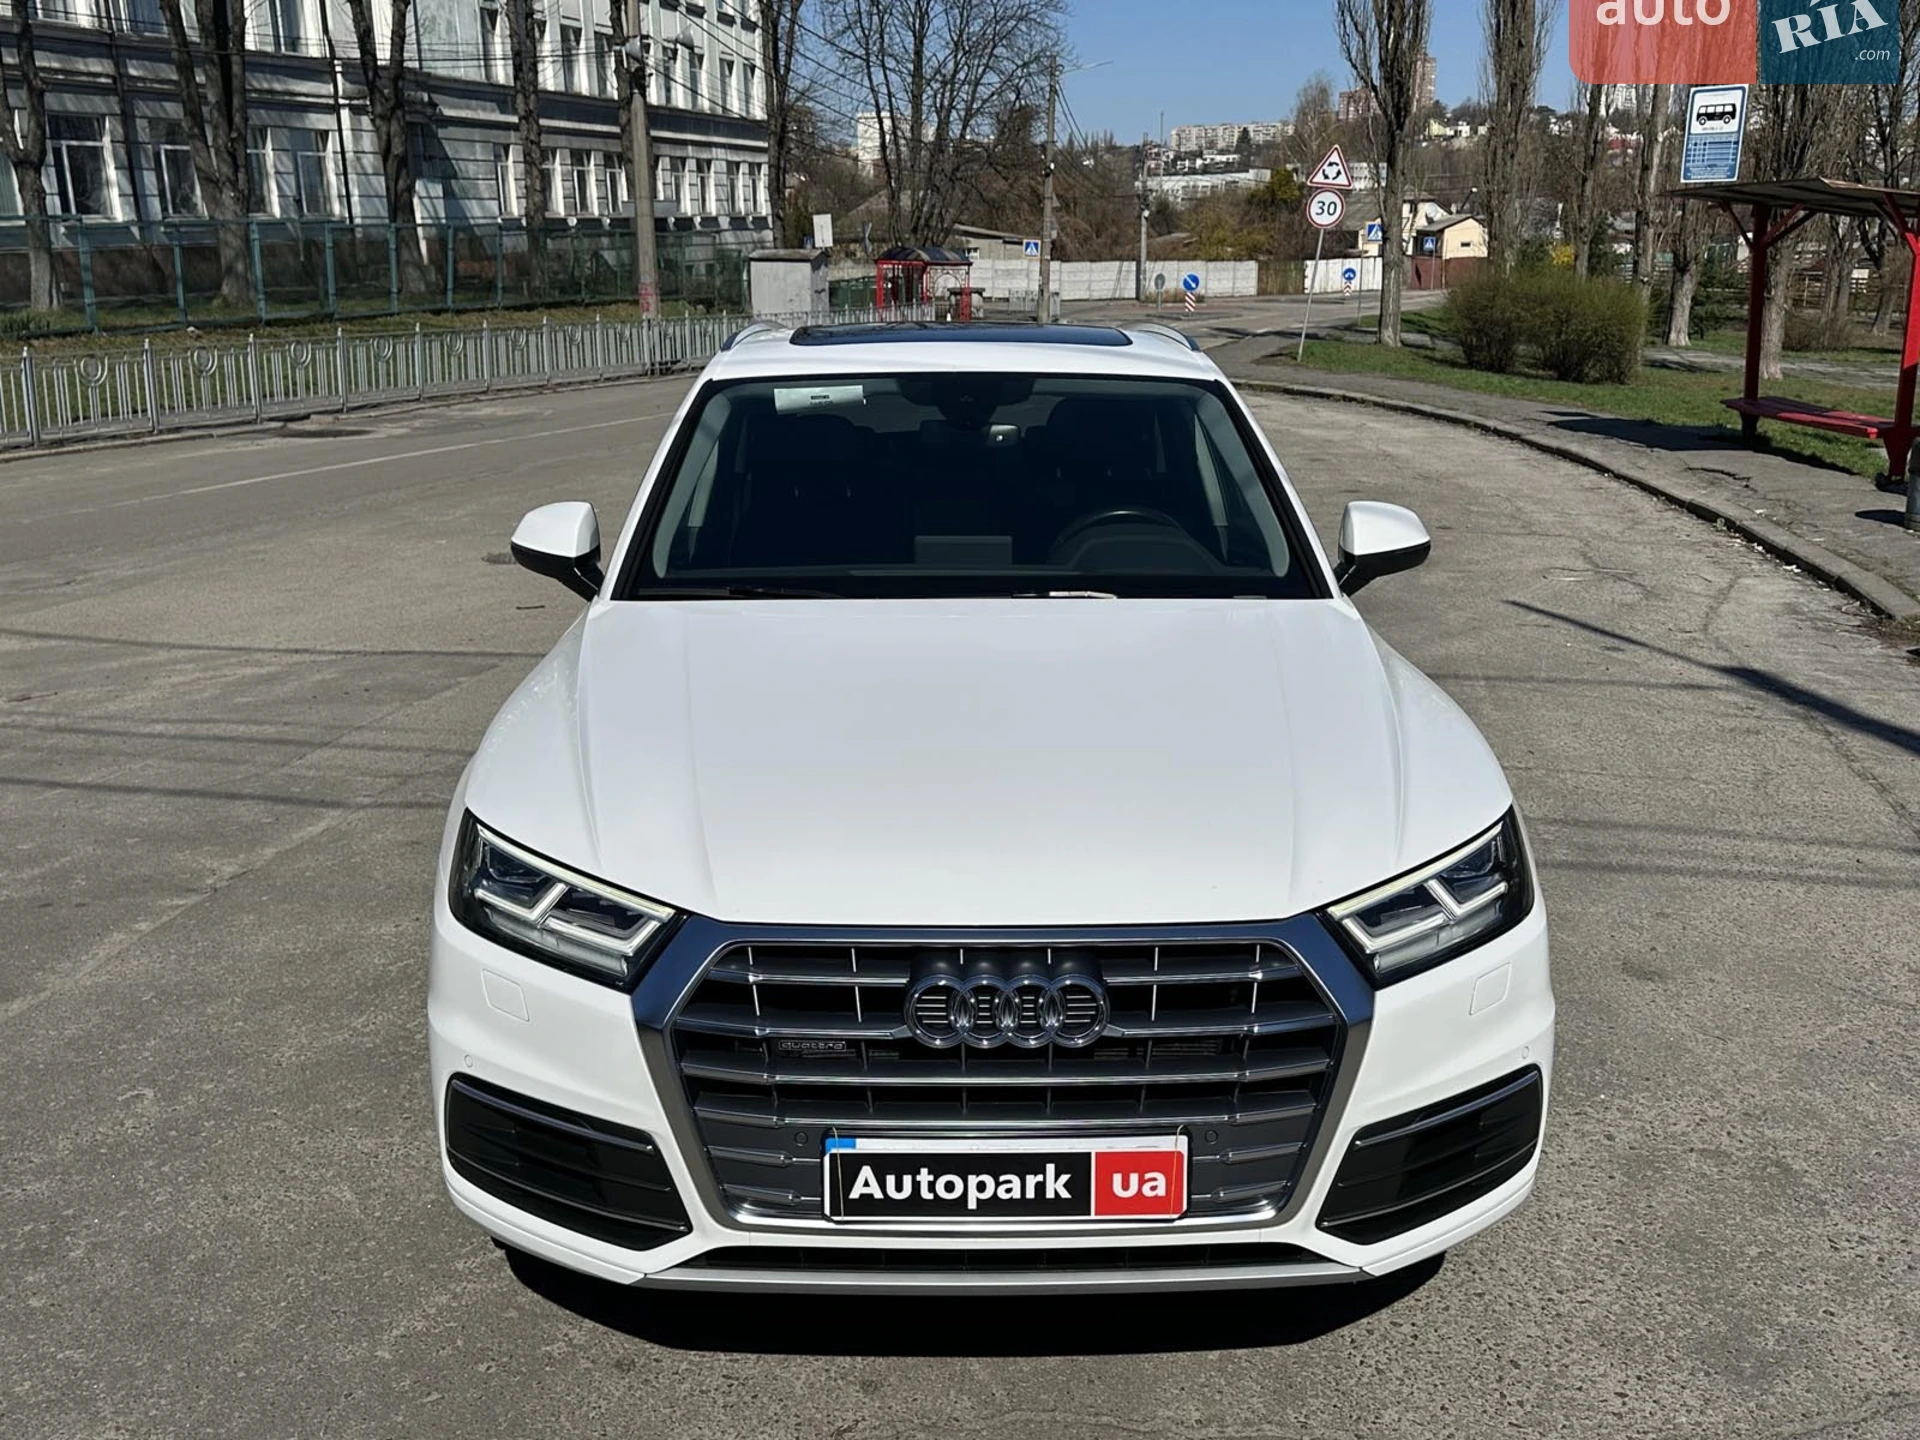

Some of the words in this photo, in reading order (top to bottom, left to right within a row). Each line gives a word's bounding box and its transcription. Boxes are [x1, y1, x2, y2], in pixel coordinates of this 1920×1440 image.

[1315, 200, 1338, 217] 30
[781, 1041, 845, 1051] quattro
[848, 1163, 1072, 1209] Autopark
[1111, 1172, 1167, 1198] ua
